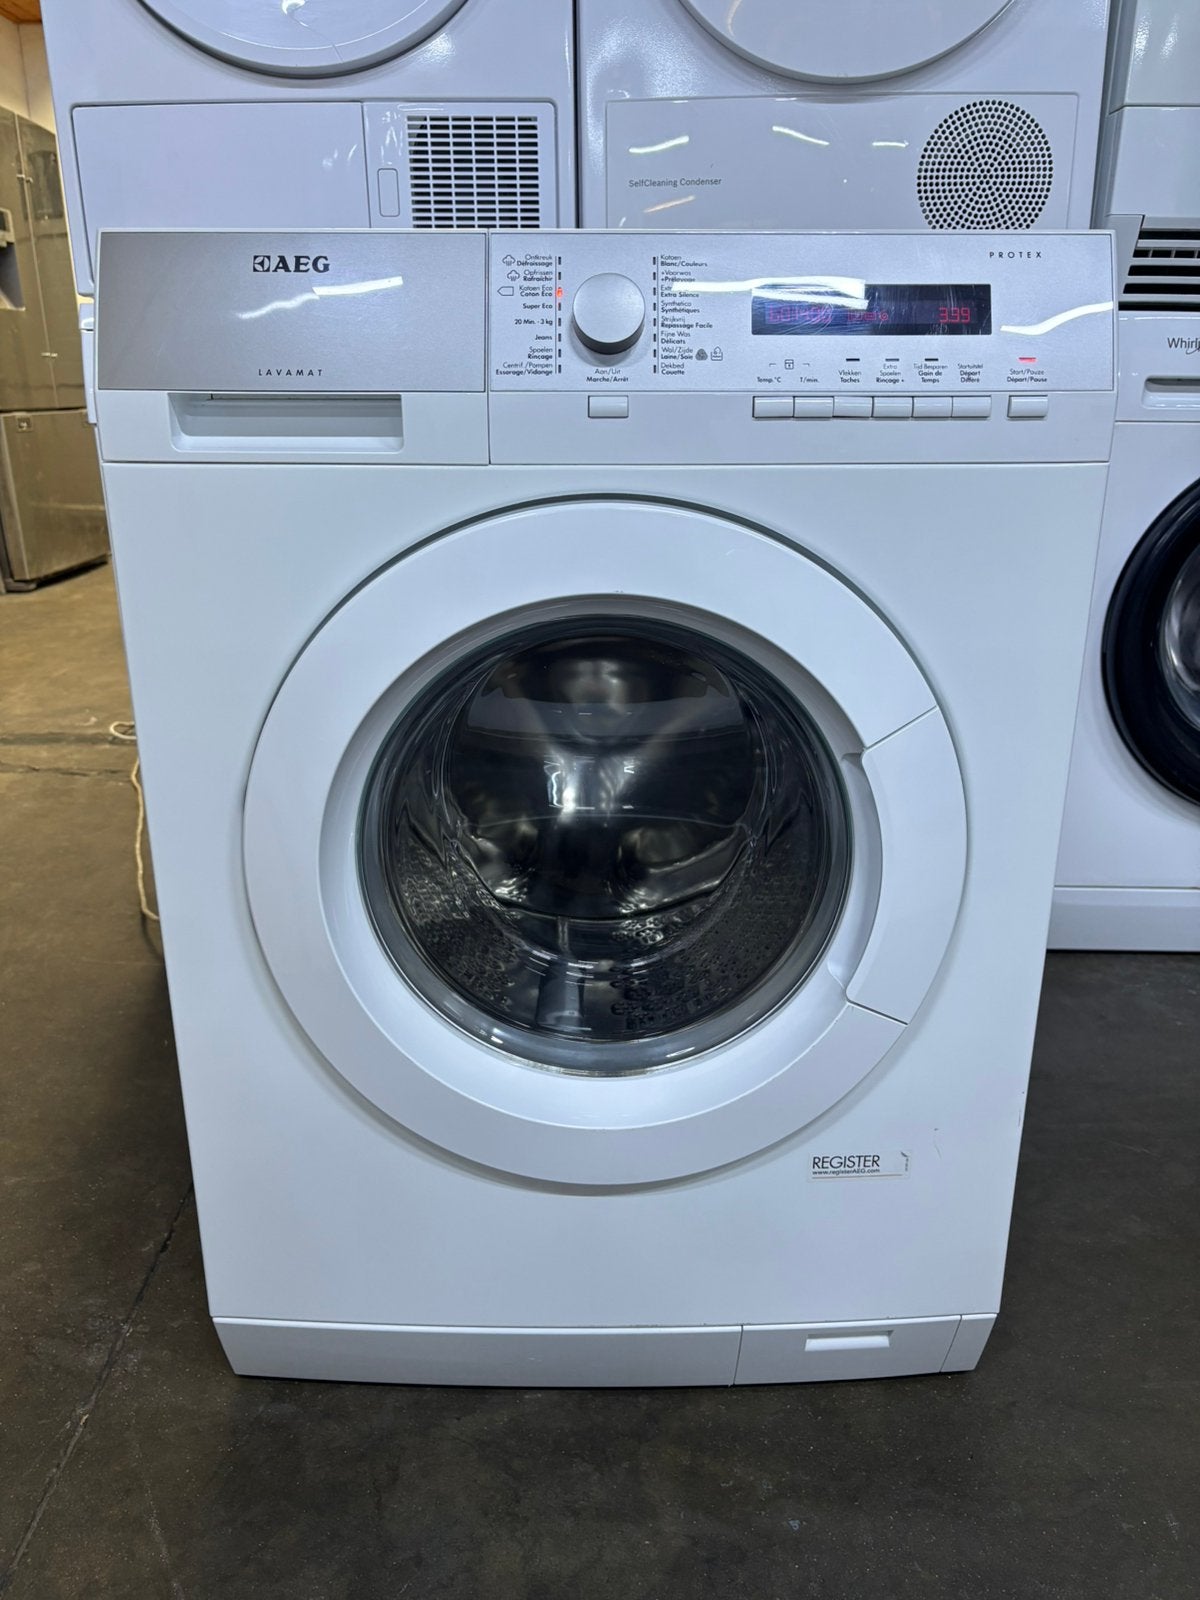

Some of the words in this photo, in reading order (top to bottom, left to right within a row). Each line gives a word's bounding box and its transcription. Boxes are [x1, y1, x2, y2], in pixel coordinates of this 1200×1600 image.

[628, 179, 678, 188] SelfCleaning
[680, 178, 722, 186] Condenser
[989, 251, 1042, 259] PROTEX
[272, 255, 330, 273] AEG
[1167, 337, 1200, 350] Whirl
[529, 346, 553, 354] Spoelen
[880, 369, 901, 377] Spoelen
[812, 1155, 881, 1170] REGISTER
